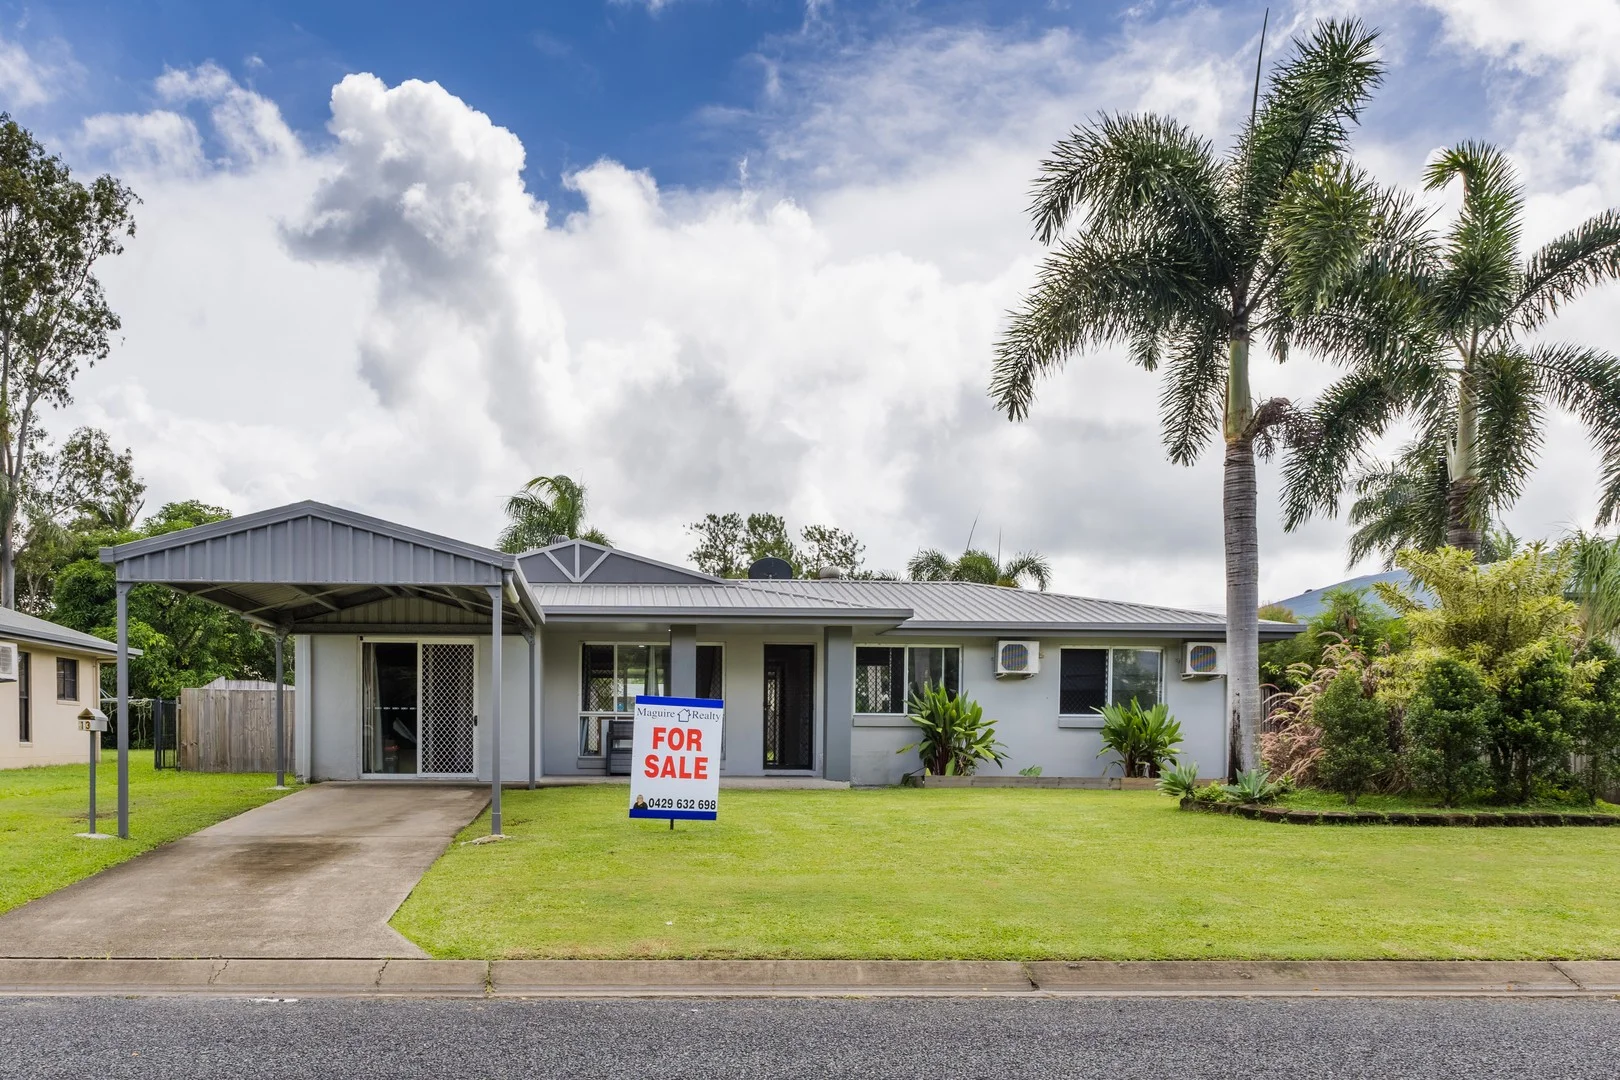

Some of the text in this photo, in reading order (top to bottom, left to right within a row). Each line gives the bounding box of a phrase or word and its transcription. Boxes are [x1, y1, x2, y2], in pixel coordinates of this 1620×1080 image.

[636, 707, 721, 723] Maguire Realty
[652, 727, 702, 751] FOR
[644, 754, 708, 779] SALE
[648, 798, 716, 810] 0429 632 698
